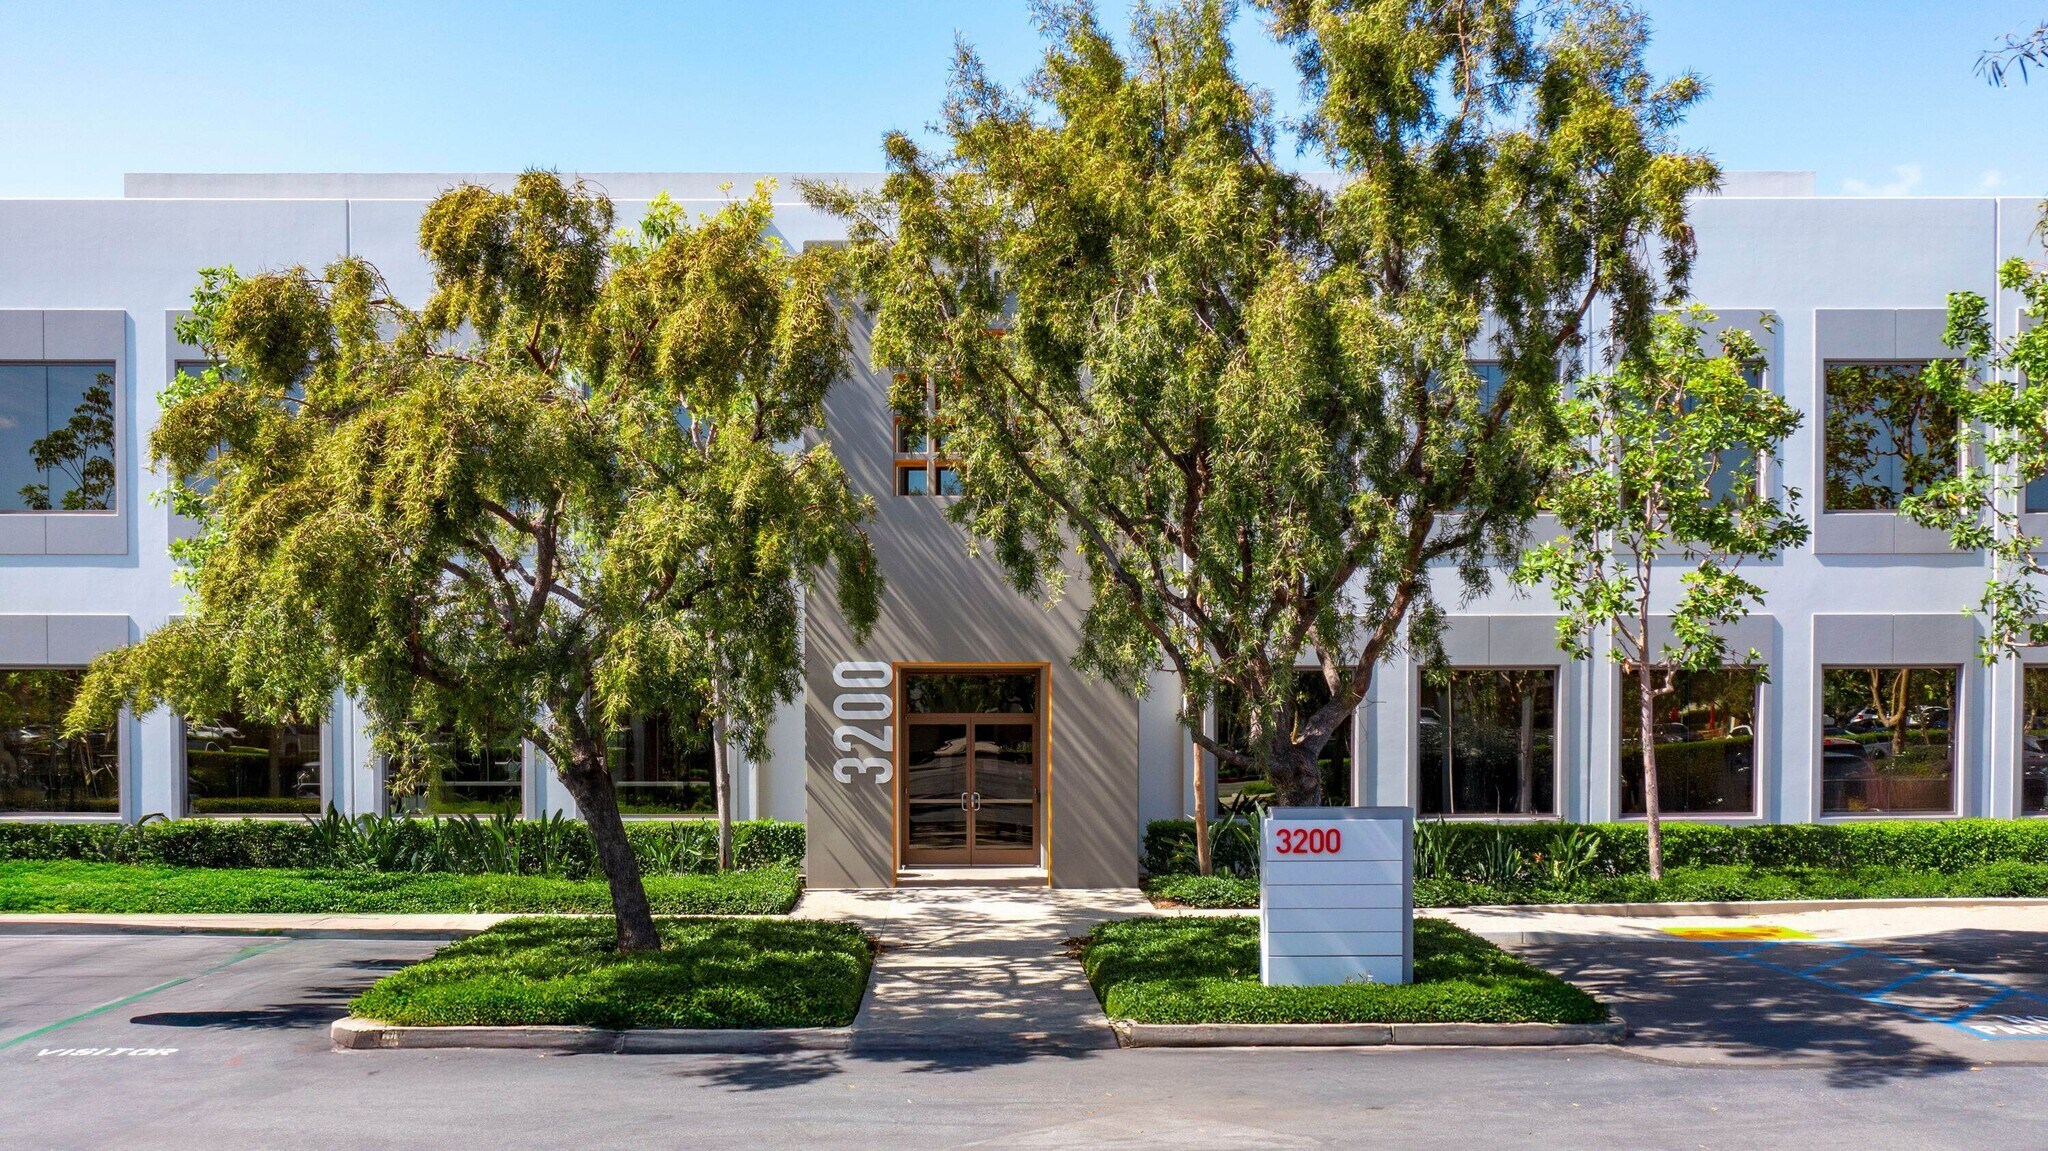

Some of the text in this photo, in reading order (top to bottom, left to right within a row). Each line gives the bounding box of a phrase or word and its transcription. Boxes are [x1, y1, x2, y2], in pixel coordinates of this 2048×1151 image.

[833, 661, 893, 784] 3200
[1275, 828, 1342, 854] 3200
[1968, 1024, 2048, 1035] PAR
[36, 1048, 179, 1057] VISITOR
